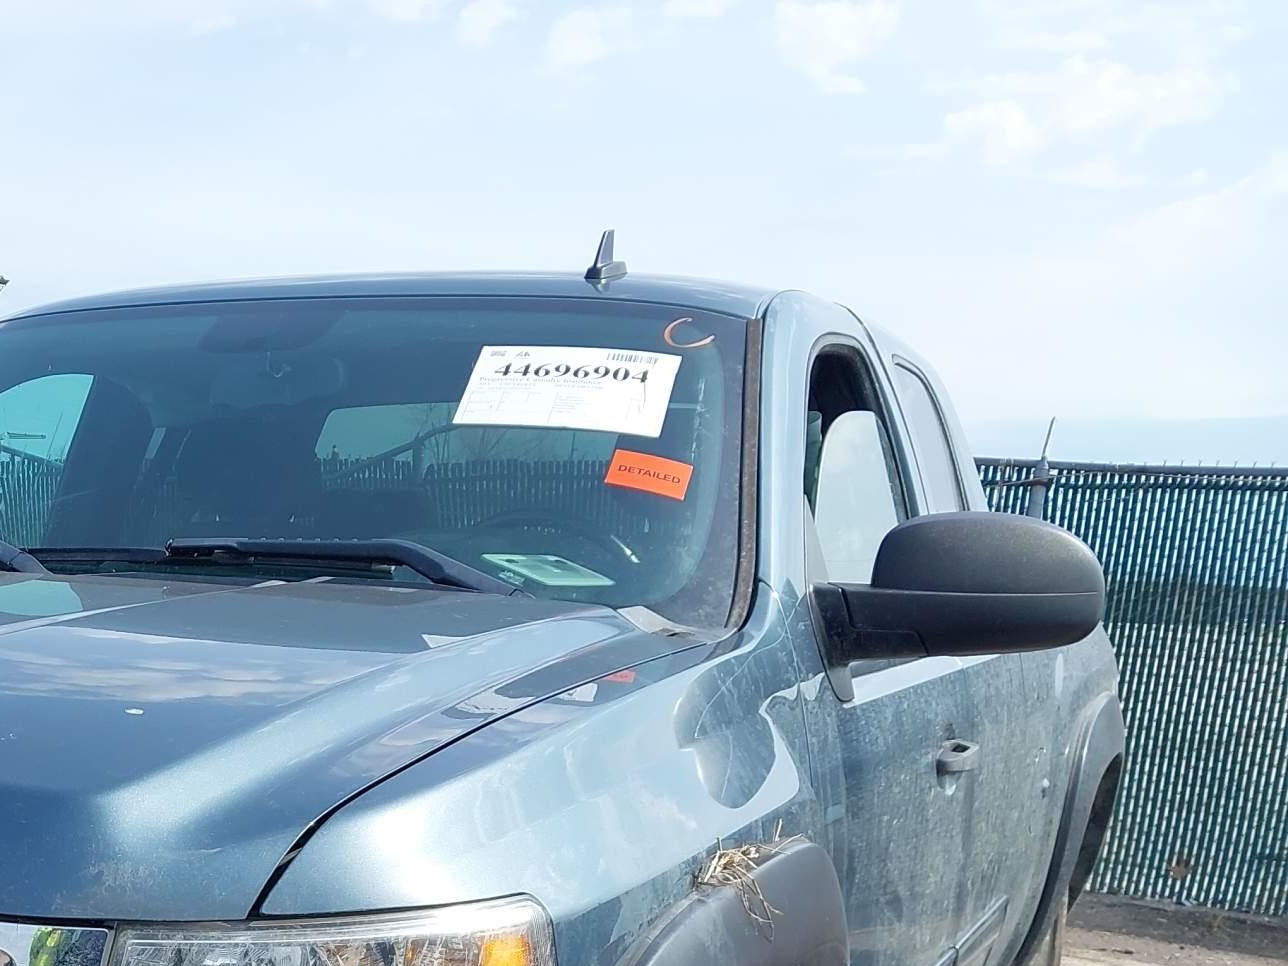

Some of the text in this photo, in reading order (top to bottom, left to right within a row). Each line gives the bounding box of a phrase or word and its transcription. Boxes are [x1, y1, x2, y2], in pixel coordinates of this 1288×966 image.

[663, 317, 715, 348] C
[494, 362, 649, 384] 44696904
[618, 464, 681, 485] DETAILED
